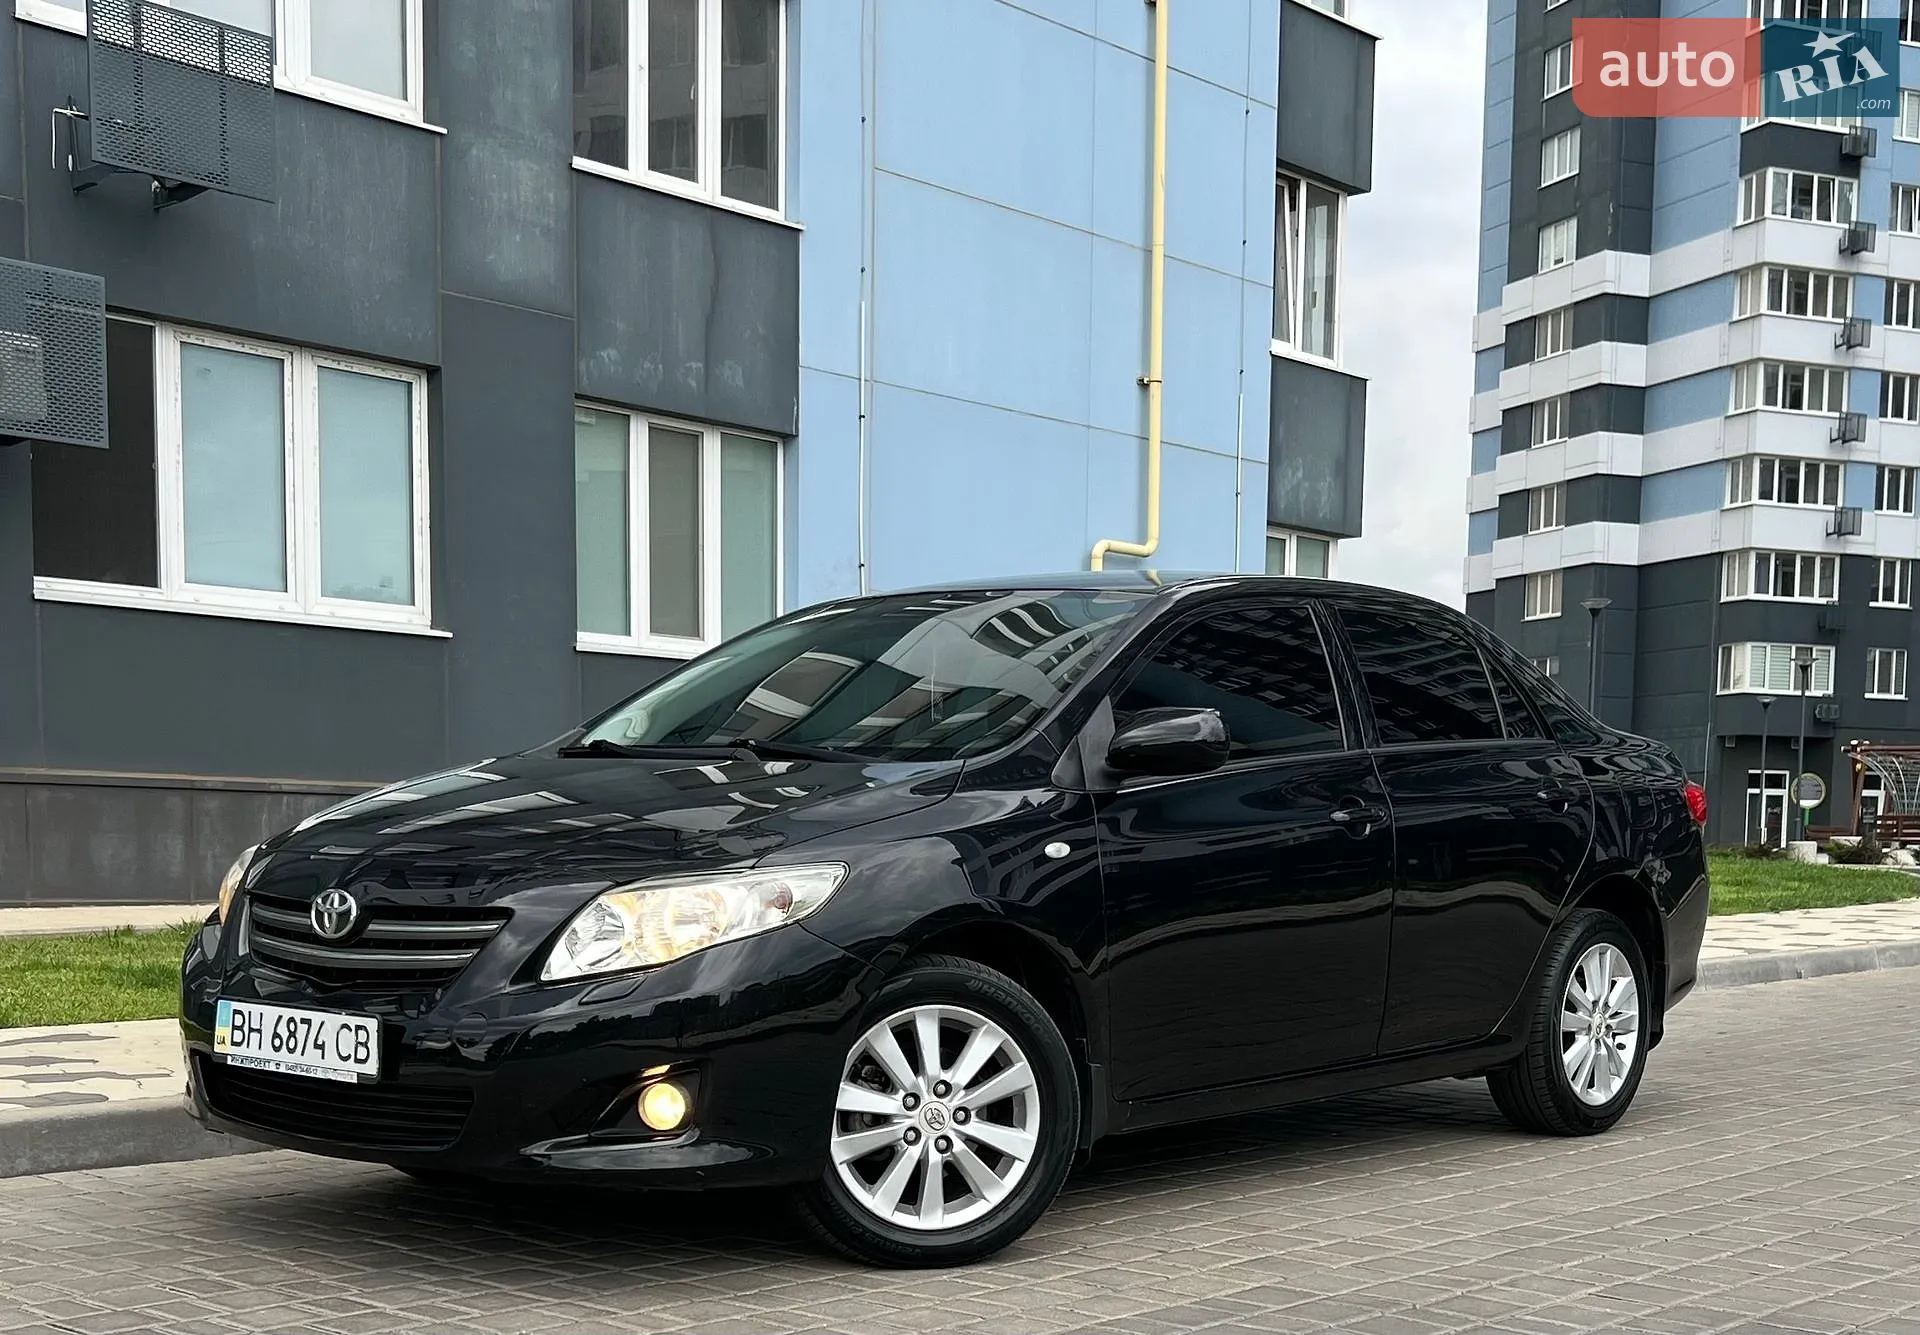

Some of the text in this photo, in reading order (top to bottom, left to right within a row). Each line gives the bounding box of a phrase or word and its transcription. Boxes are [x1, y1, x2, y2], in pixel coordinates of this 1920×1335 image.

[216, 1035, 227, 1046] UA
[230, 1009, 371, 1064] BH 6874 CB
